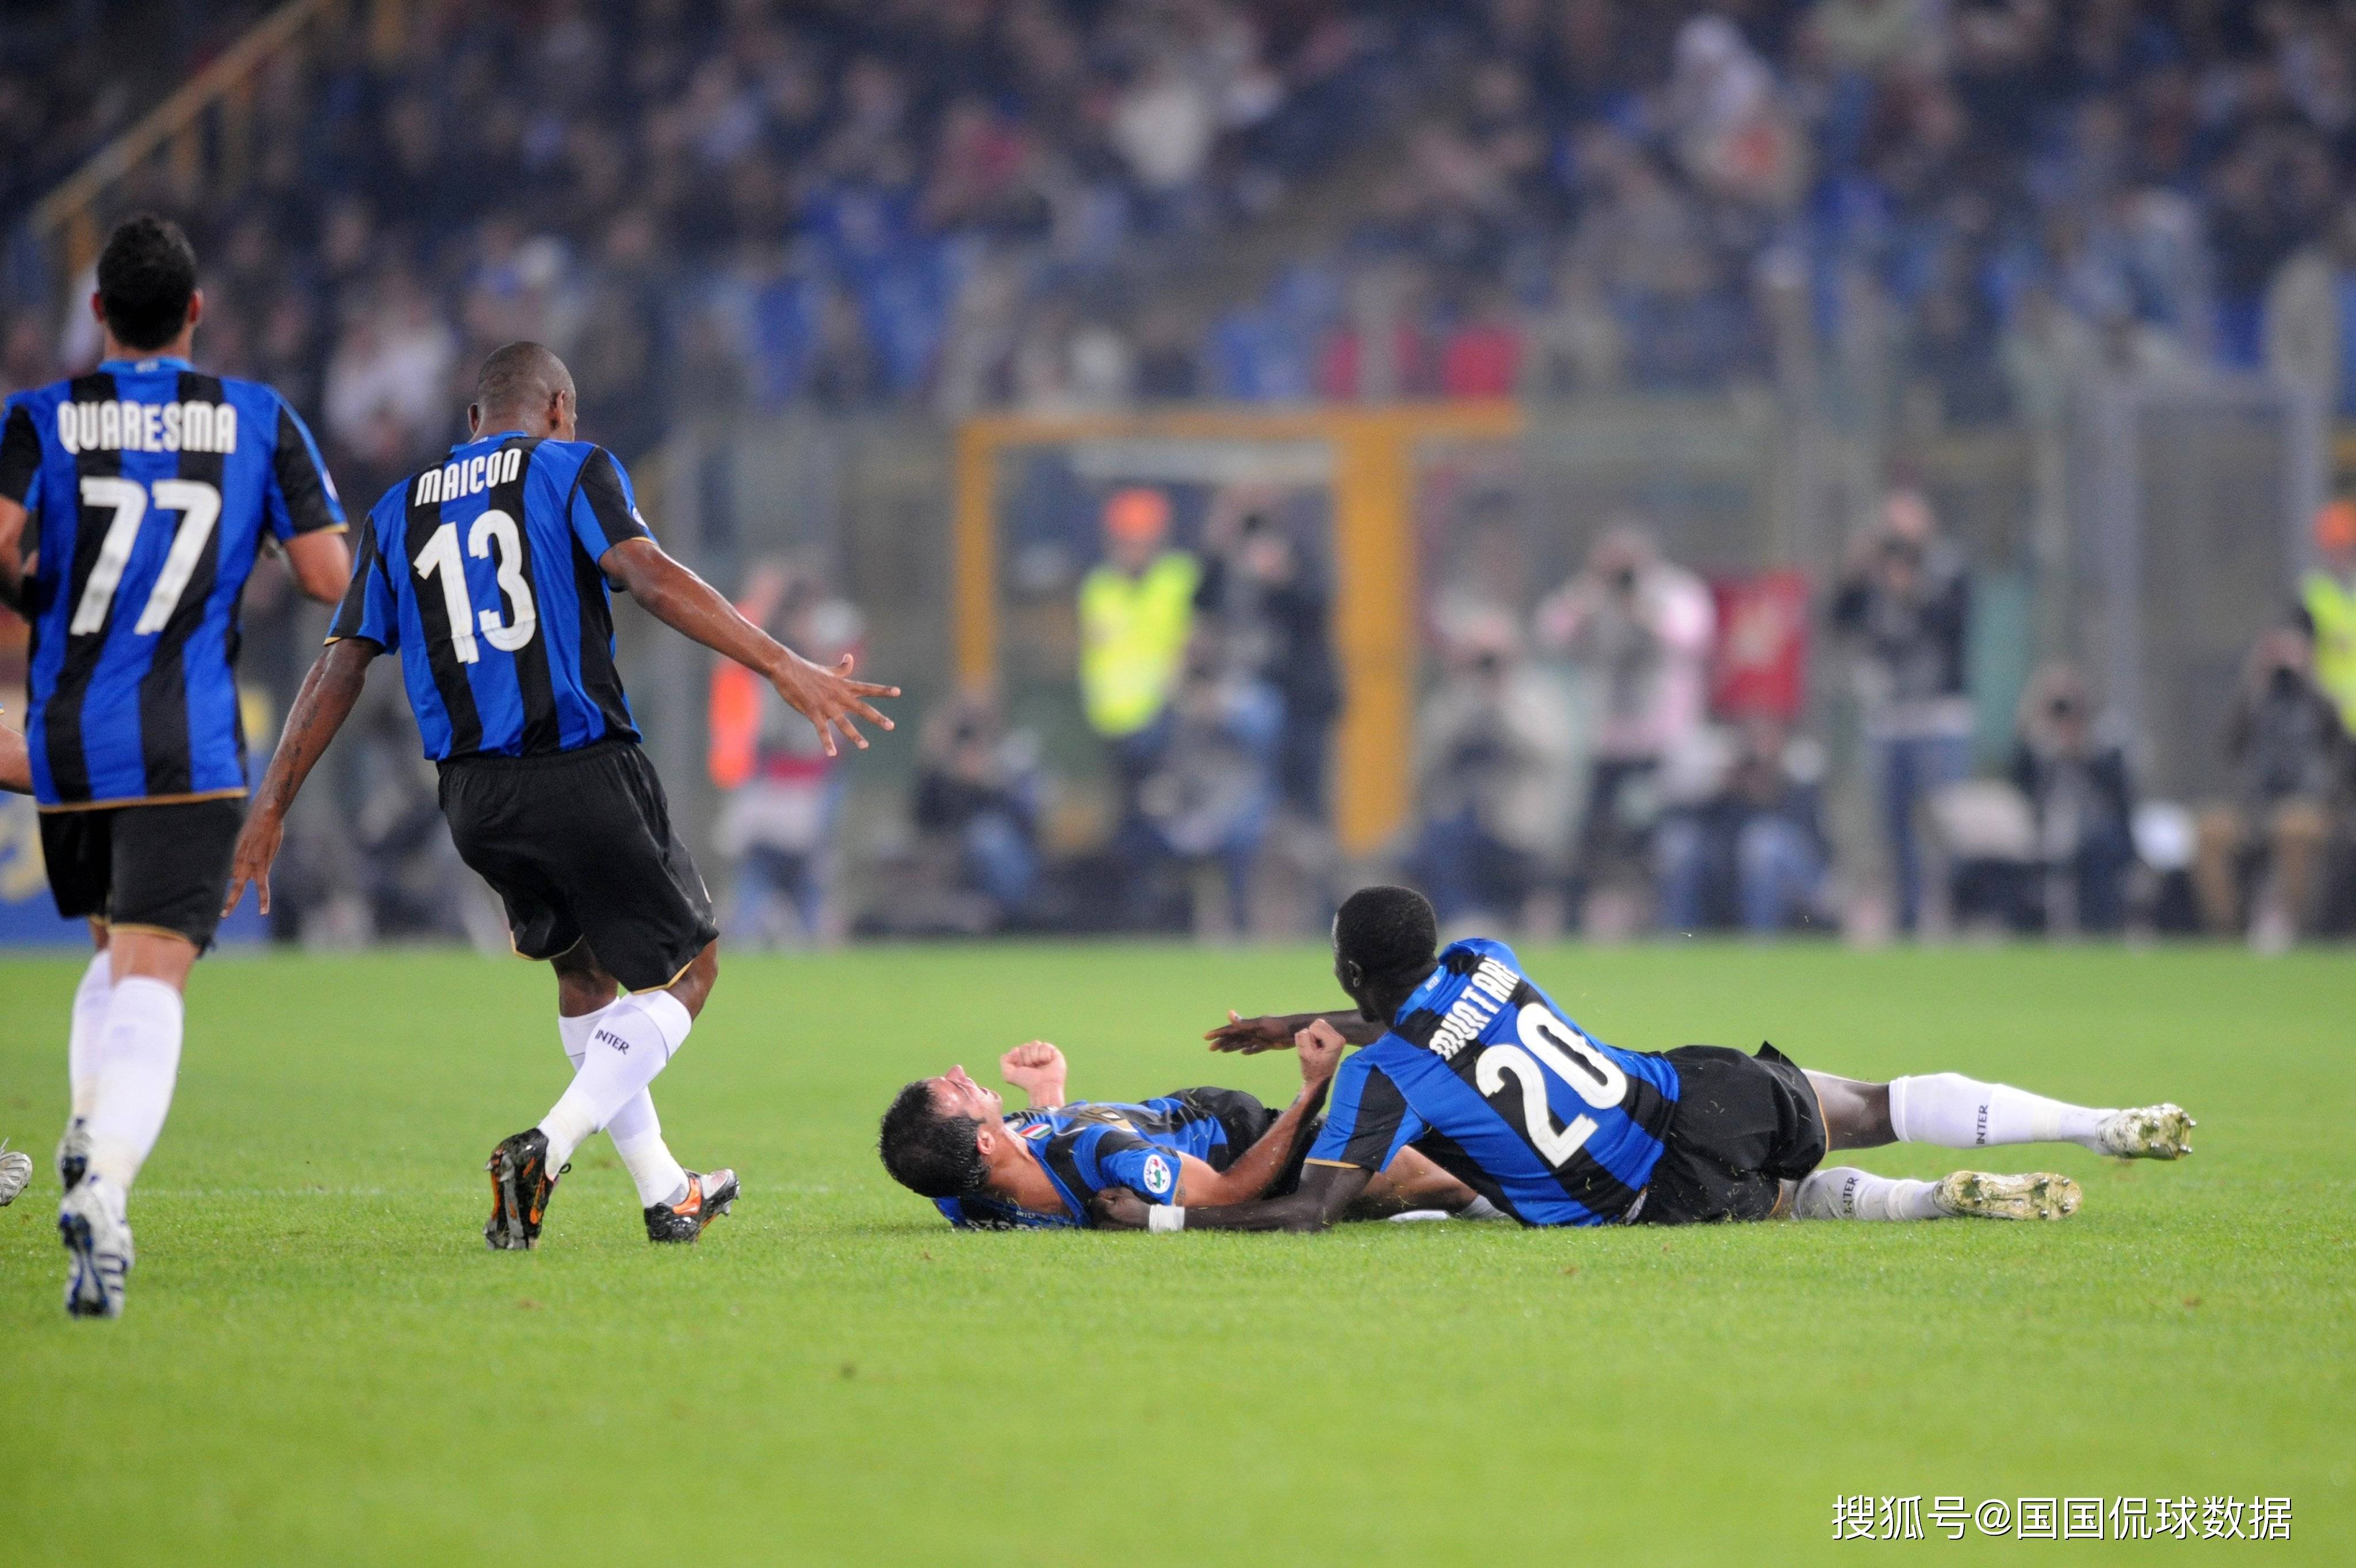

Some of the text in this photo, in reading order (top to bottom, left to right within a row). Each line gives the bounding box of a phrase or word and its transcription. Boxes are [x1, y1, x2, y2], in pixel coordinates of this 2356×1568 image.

[58, 400, 237, 454] QUARESMA
[415, 448, 522, 507] MAICON
[70, 476, 222, 636] 77
[413, 509, 536, 664] 13
[595, 1029, 630, 1055] INTER
[1475, 1003, 1628, 1168] 20
[1976, 1104, 1988, 1145] INTER
